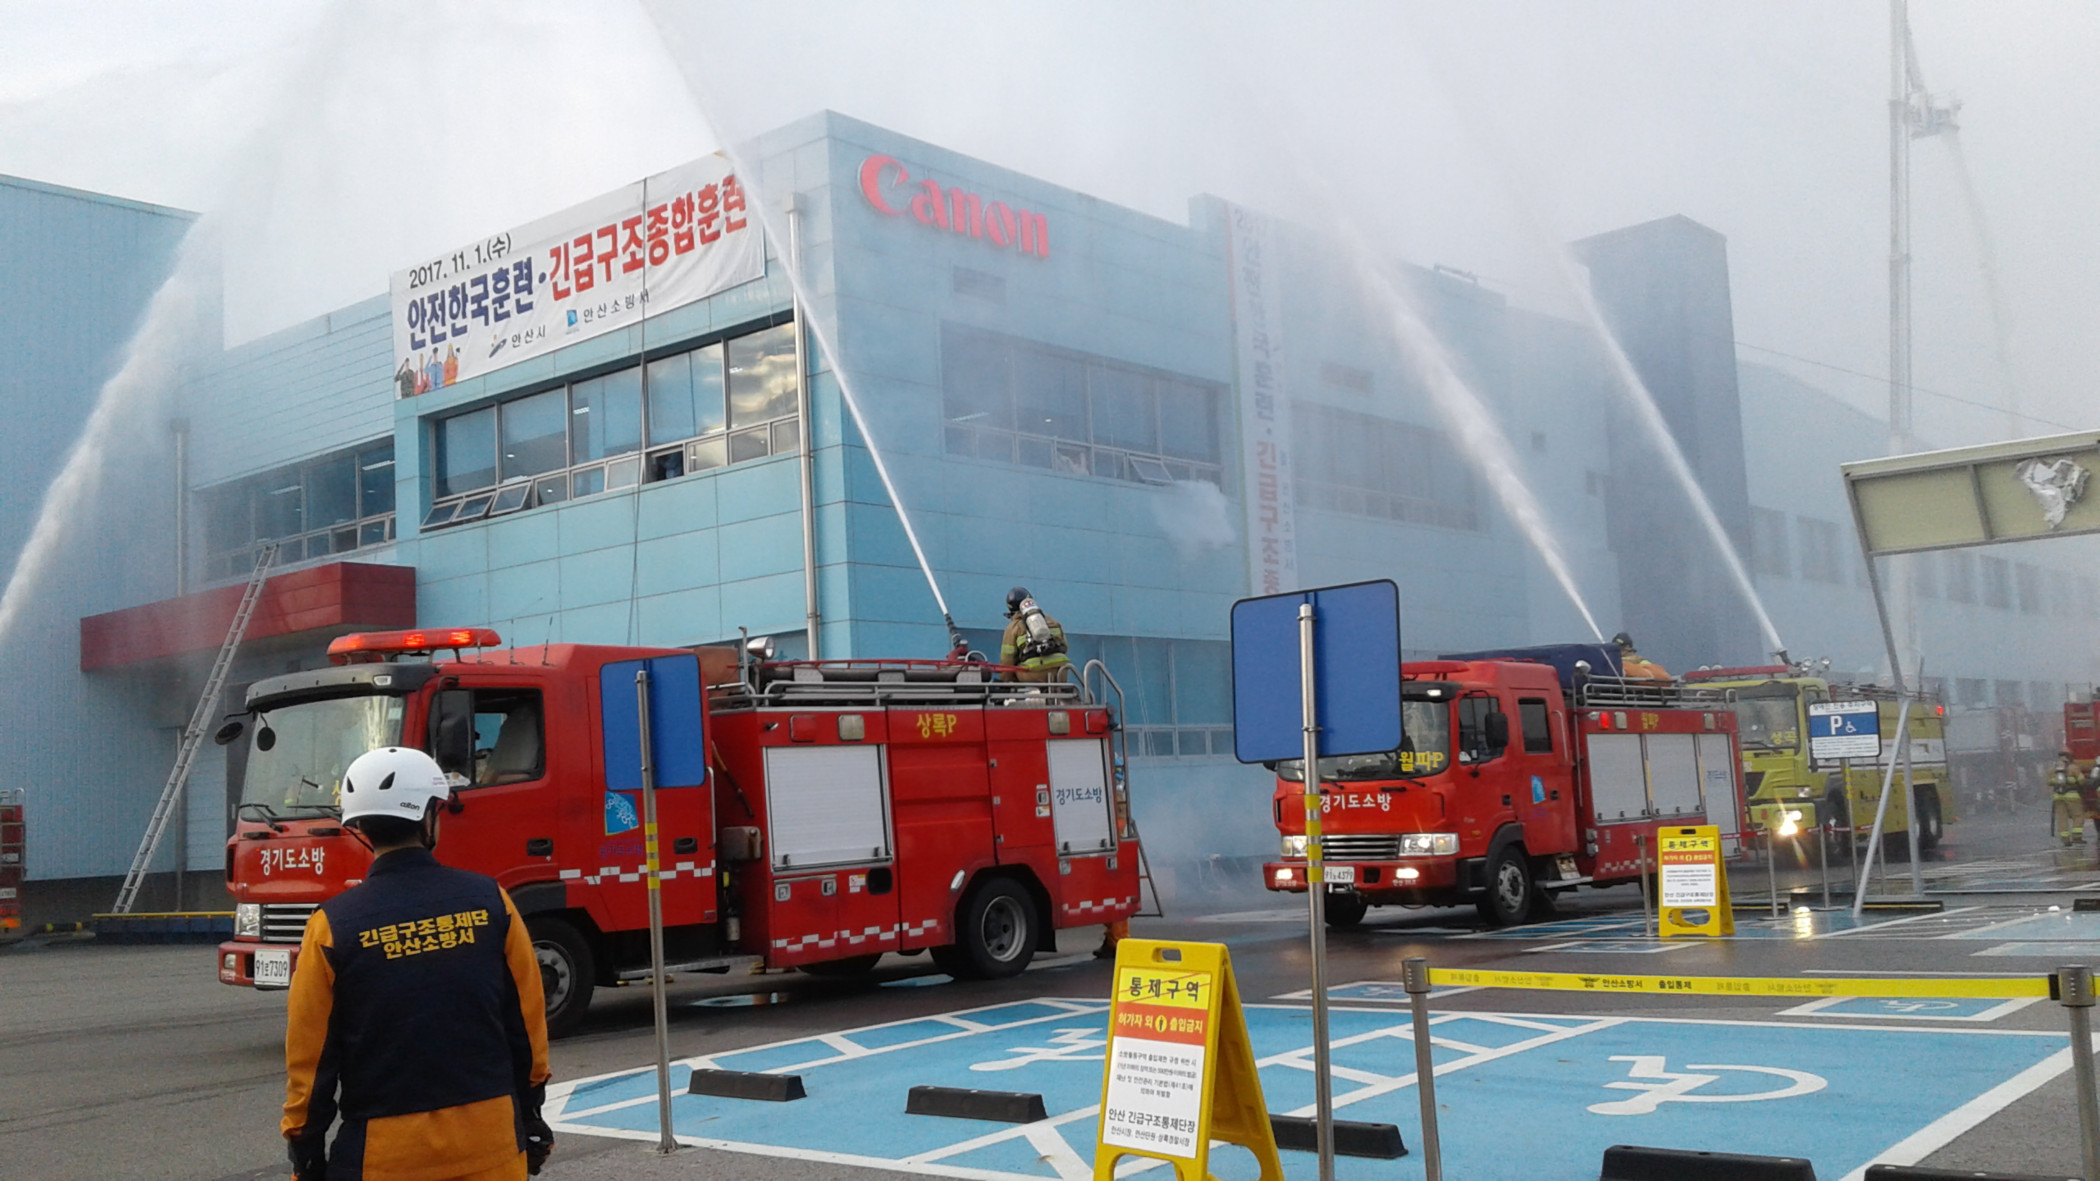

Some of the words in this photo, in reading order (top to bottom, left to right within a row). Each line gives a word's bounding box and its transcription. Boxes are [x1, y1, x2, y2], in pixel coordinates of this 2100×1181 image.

[857, 153, 1049, 259] Canon
[583, 289, 650, 322] 안산소방서
[511, 325, 546, 348] 안산시
[916, 713, 957, 738] 상록P
[1830, 715, 1843, 735] P
[1056, 786, 1102, 805] 경기도소방
[1320, 793, 1392, 813] 경기도소방
[260, 846, 325, 876] 경기도소방
[359, 909, 489, 948] 긴급구조통제단
[383, 928, 475, 960] 안산소방서
[1130, 977, 1199, 1002] 통제구역
[1602, 978, 1643, 988] 안산소방서
[1659, 980, 1692, 990] 출입통제
[1169, 1017, 1204, 1034] 출입금지
[1109, 1108, 1126, 1122] 안산
[1128, 1110, 1196, 1133] 긴급구조통제단장
